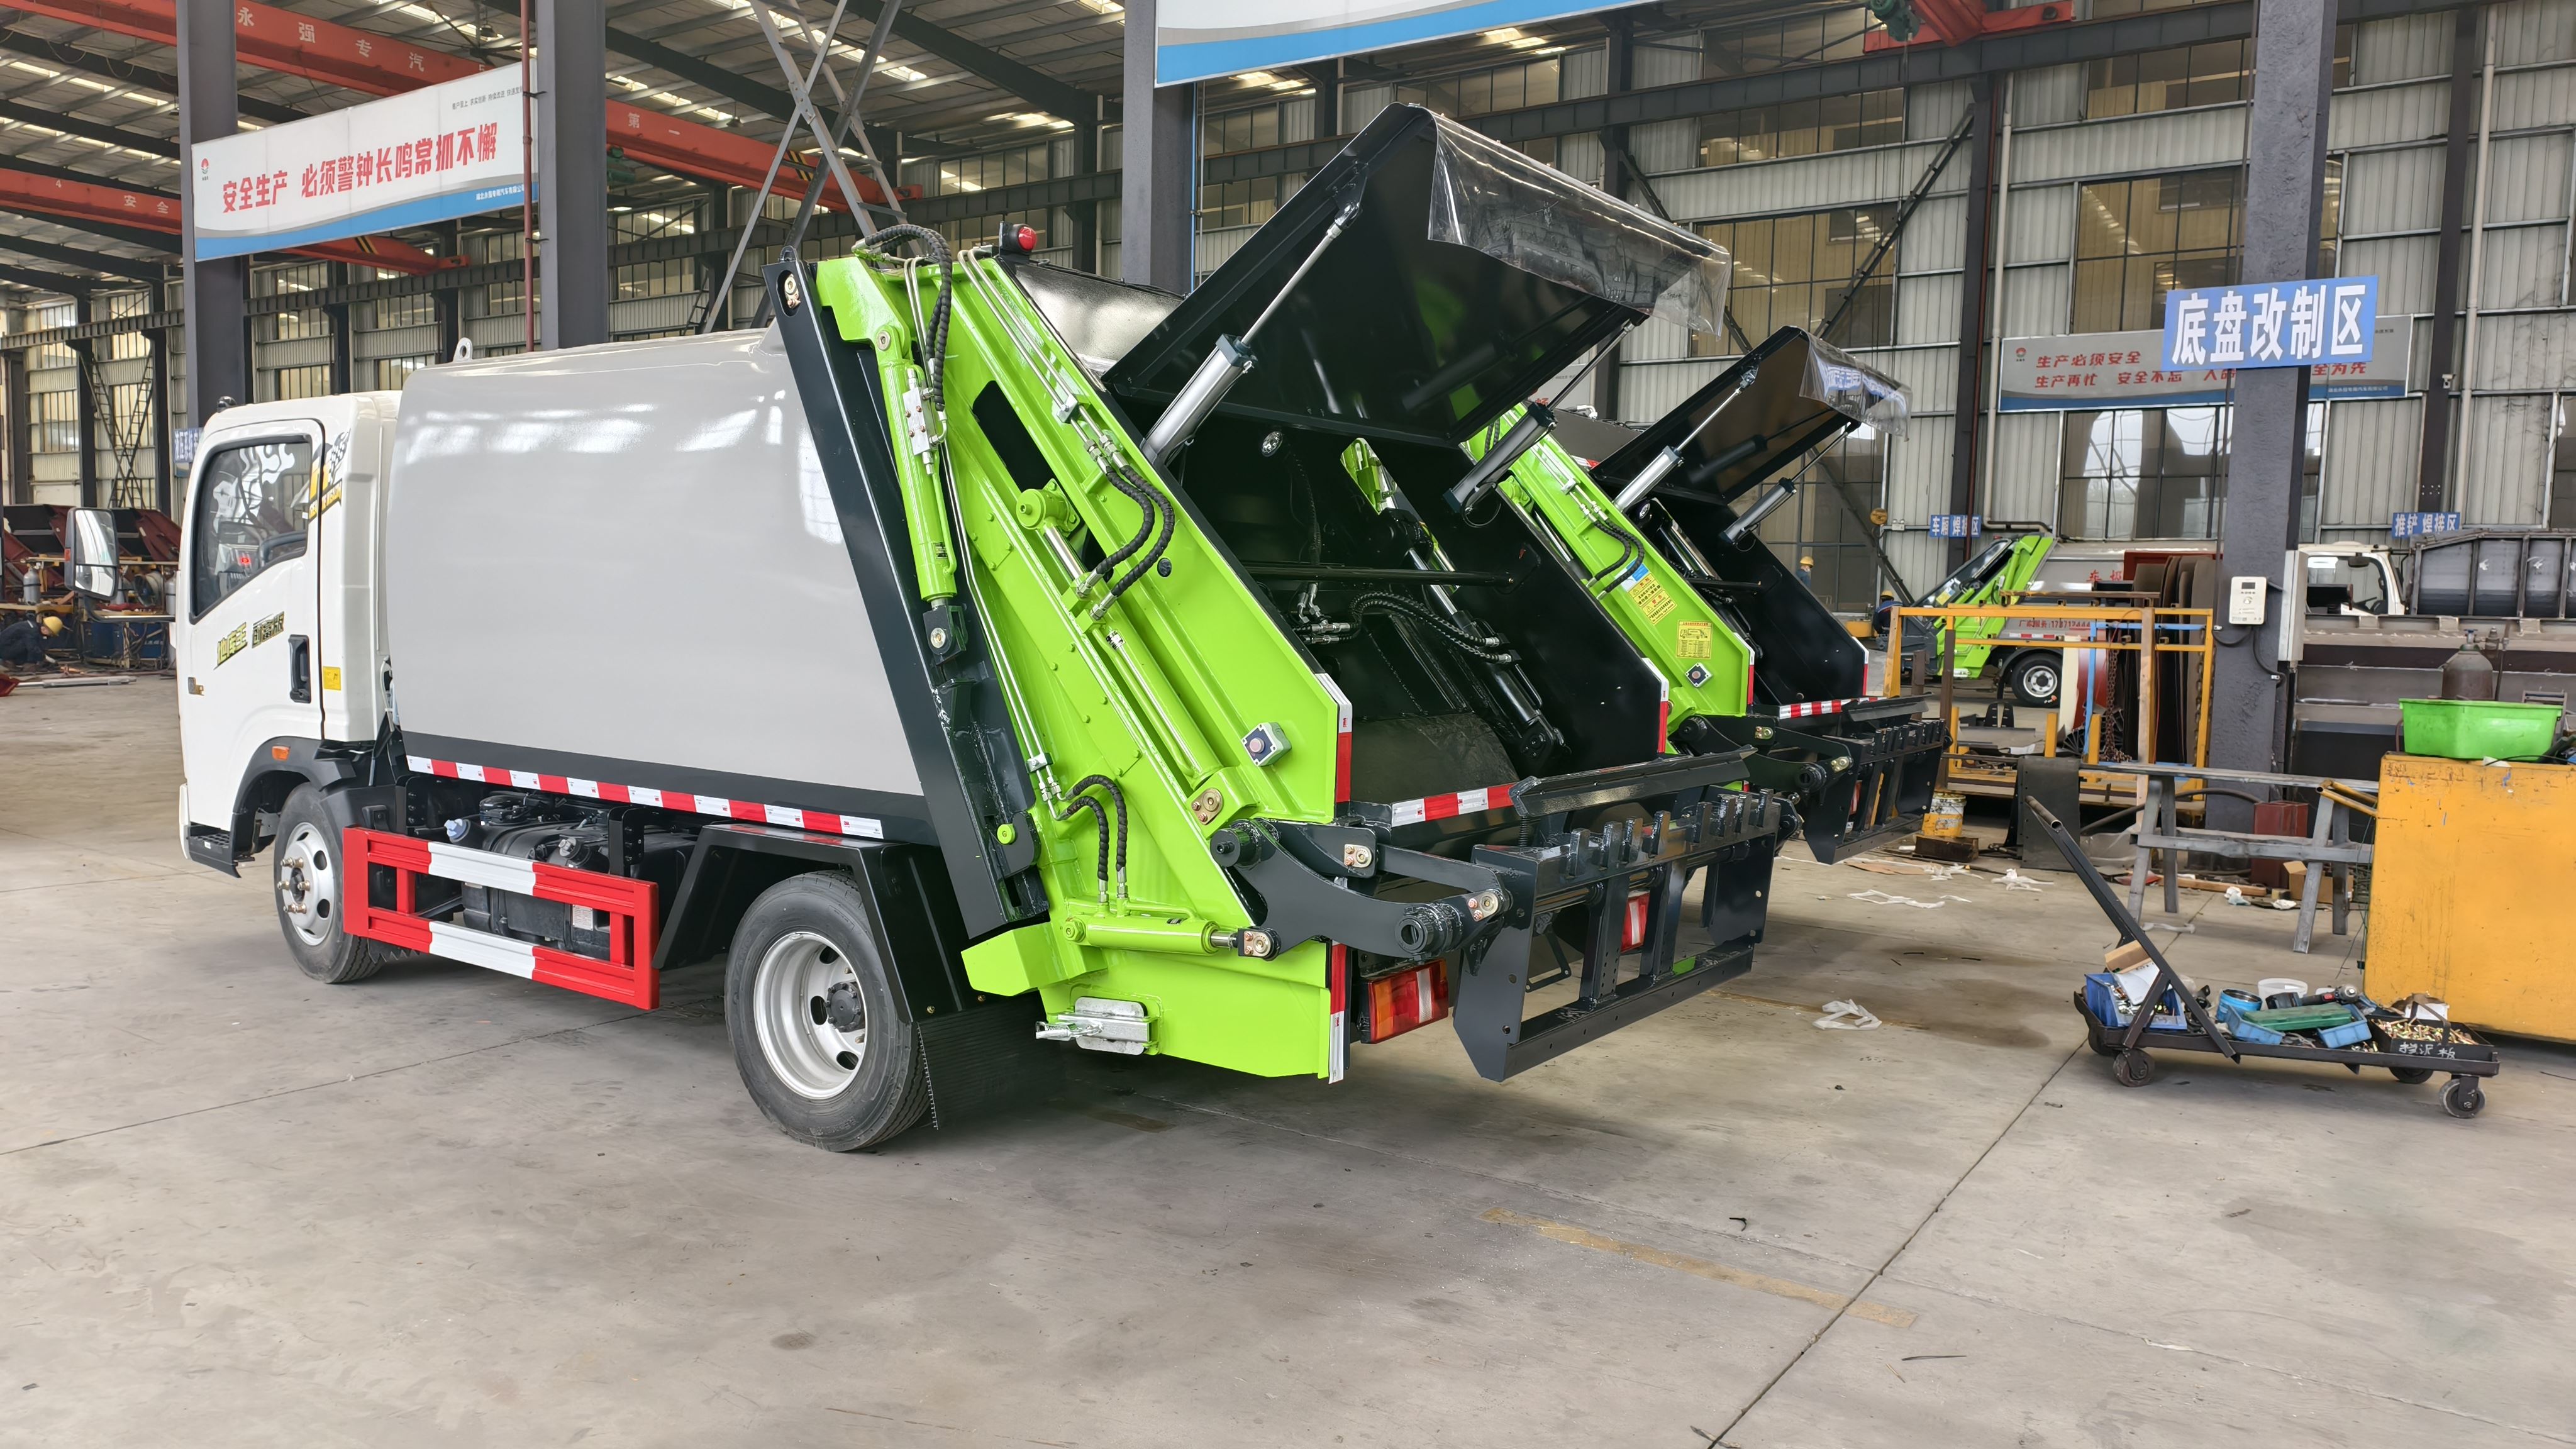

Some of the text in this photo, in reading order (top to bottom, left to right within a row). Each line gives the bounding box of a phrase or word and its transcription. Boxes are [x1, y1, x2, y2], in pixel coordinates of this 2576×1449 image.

[223, 122, 497, 213] 安全生产 必须警钟长鸣常抓不懈
[124, 194, 169, 214] 安全
[2171, 284, 2366, 365] 底盘改制区
[2036, 351, 2141, 369] 生产必须安全
[2035, 373, 2099, 389] 生产再忙
[2117, 370, 2183, 386] 安全不忘
[1931, 516, 1949, 536] 车厢
